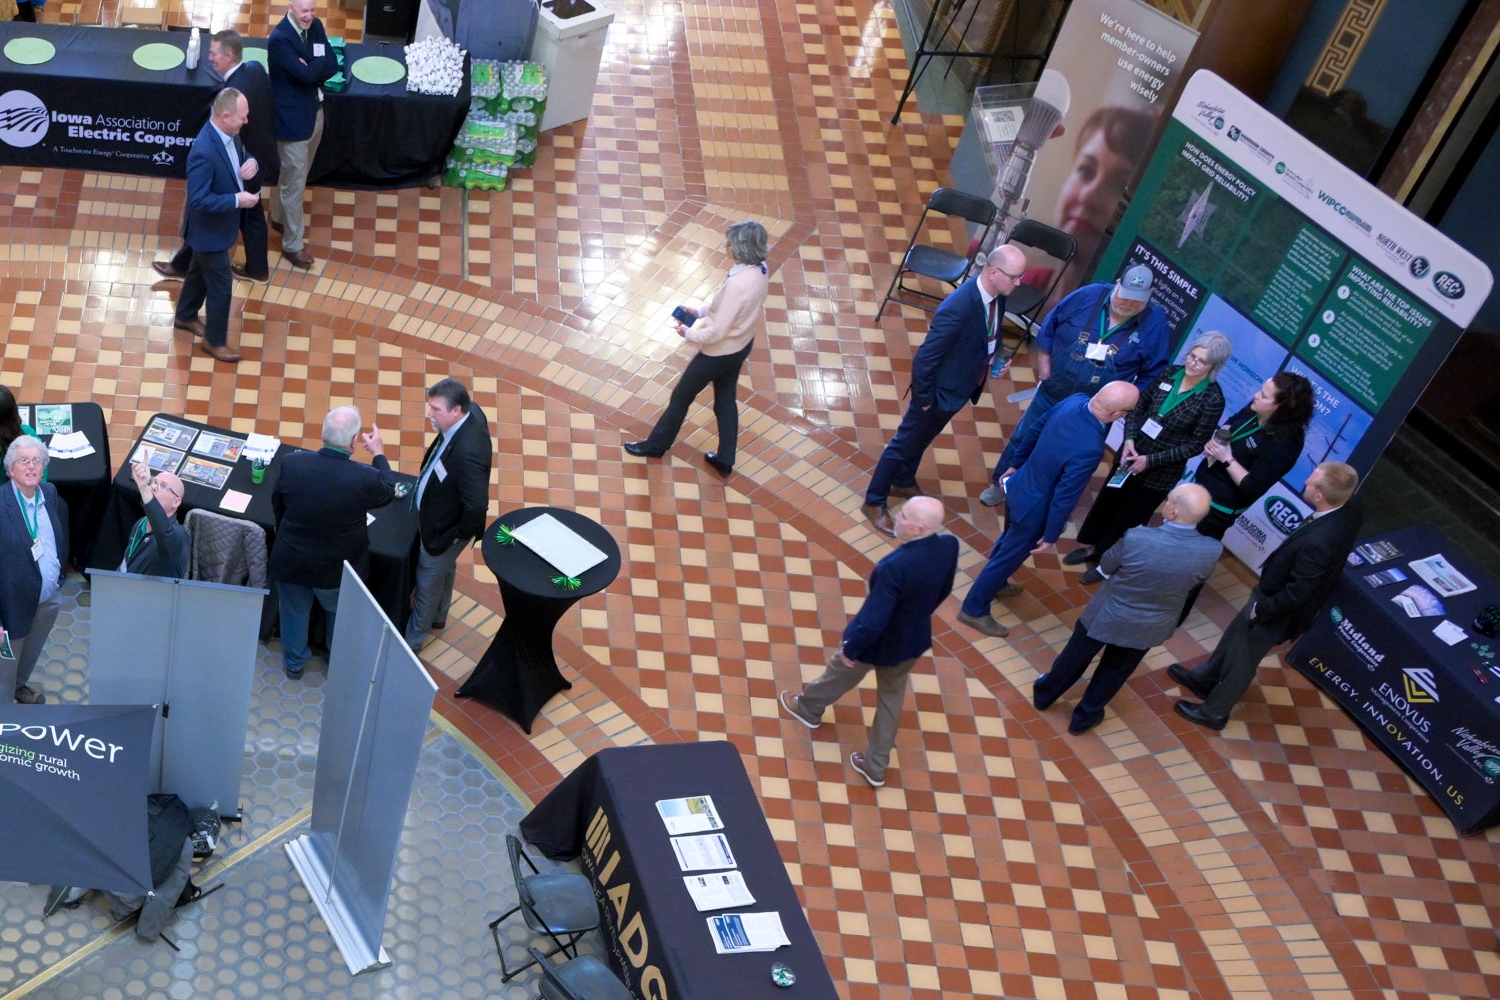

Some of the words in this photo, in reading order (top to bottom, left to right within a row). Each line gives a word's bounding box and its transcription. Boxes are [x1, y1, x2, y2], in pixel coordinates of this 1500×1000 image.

[1100, 12, 1125, 34] We're
[1125, 26, 1146, 45] here
[1146, 39, 1156, 51] to
[1156, 44, 1177, 63] help
[1100, 32, 1171, 76] member-owners
[1117, 57, 1134, 72] use
[1134, 67, 1164, 91] energy
[1130, 81, 1158, 104] wisely
[51, 111, 93, 126] Iowa
[95, 114, 166, 131] Association
[167, 119, 181, 132] of
[68, 125, 131, 142] Electric
[60, 146, 92, 156] Touchstone
[1181, 149, 1203, 170] IMPACT
[1201, 163, 1215, 178] GRID
[1214, 173, 1249, 202] RELIABILITY?
[1185, 142, 1201, 156] HOW
[1200, 152, 1215, 167] DOES
[1214, 161, 1237, 183] ENERGY
[1235, 176, 1257, 197] POLICY
[1318, 190, 1347, 216] WIPCO
[1376, 233, 1397, 250] NORTH
[1395, 246, 1414, 263] WEST
[1135, 244, 1151, 261] IT'S
[1150, 255, 1169, 275] THIS
[1167, 271, 1198, 299] SIMPLE.
[1158, 279, 1172, 294] lights
[1171, 292, 1180, 301] on
[1347, 272, 1382, 301] IMPACTING
[1381, 298, 1422, 329] RELIABILITY?
[1352, 265, 1372, 283] WHAT
[1370, 280, 1385, 293] ARE
[1384, 290, 1397, 301] THE
[1396, 298, 1410, 311] TOP
[1409, 307, 1433, 327] ISSUES
[1164, 297, 1188, 319] economy
[1322, 390, 1340, 409] THE
[1338, 625, 1353, 640] Power
[1351, 637, 1379, 668] Cooperative
[1340, 617, 1385, 664] Midland
[1370, 687, 1402, 719] Management
[1400, 713, 1430, 744] Cooperative
[1378, 682, 1432, 733] ENOVUS
[1308, 656, 1359, 702] ENERGY.
[1362, 701, 1443, 785] INNOVATION.
[1446, 785, 1464, 810] US.
[1456, 740, 1486, 760] Valley
[34, 760, 81, 781] growth
[38, 753, 68, 768] rural
